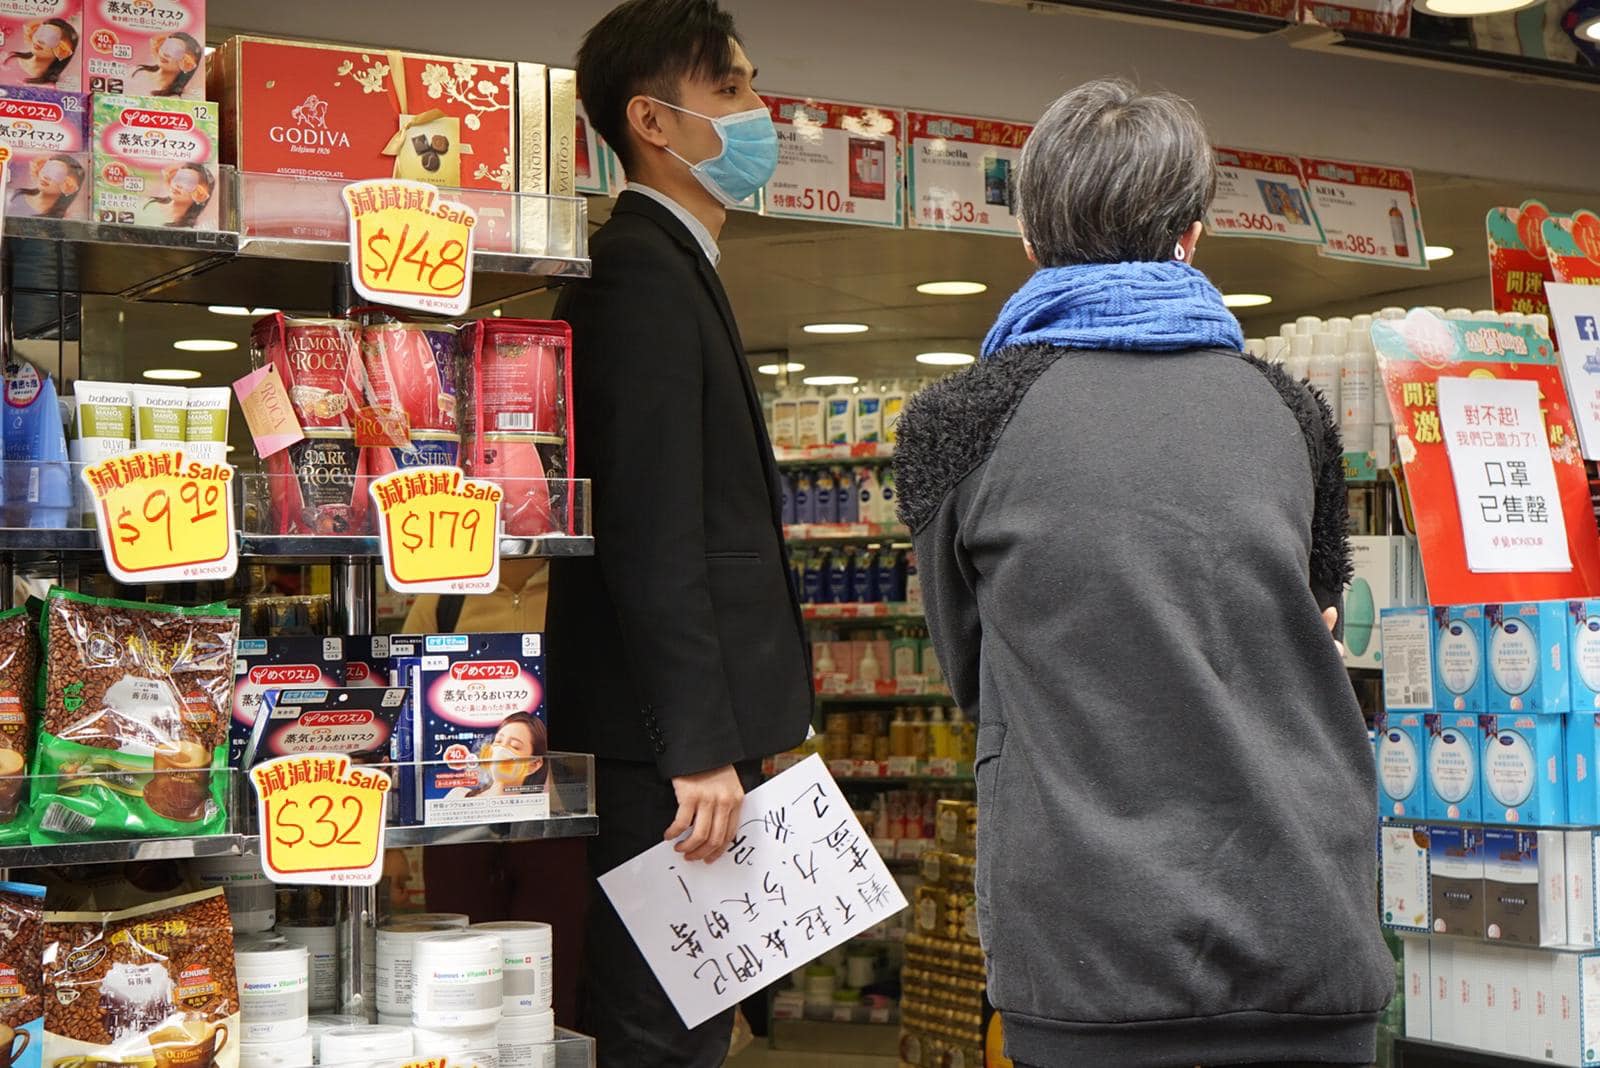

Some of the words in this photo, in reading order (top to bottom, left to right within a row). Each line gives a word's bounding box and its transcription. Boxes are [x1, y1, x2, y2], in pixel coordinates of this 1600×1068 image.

[139, 113, 189, 128] めぐりズム
[269, 125, 350, 148] GODIVA
[276, 166, 308, 175] ASSORTED
[309, 168, 344, 178] CHOCOLATE
[558, 135, 569, 194] GODIVA
[365, 223, 467, 290] $148
[1463, 405, 1520, 426] 對不起!
[1456, 431, 1538, 448] 我們已盡力了!
[304, 450, 346, 465] DARK
[401, 450, 453, 466] CASHEW
[1484, 460, 1531, 489] 口罩
[1478, 494, 1549, 524] 已售罄
[400, 508, 482, 555] $179
[267, 668, 315, 681] めぐりズム
[467, 665, 515, 677] めぐりズム
[316, 713, 368, 724] めぐりズム
[275, 794, 365, 850] $32
[244, 981, 271, 990] Aqueous
